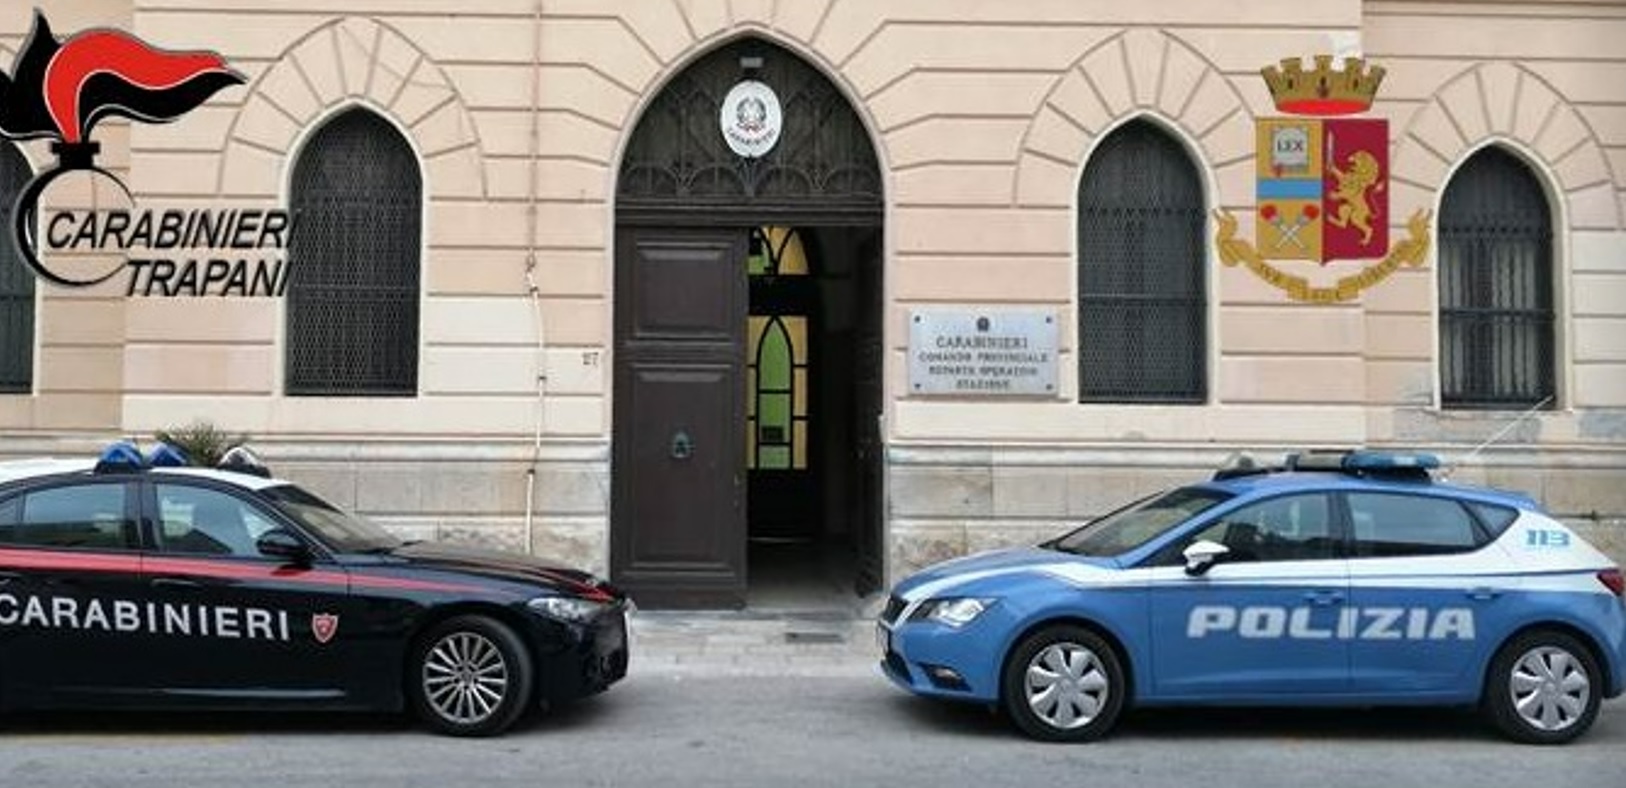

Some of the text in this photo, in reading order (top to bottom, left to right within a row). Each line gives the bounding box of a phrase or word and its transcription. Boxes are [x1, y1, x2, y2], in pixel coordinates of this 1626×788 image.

[935, 335, 1028, 349] CARABINIERI
[1525, 529, 1570, 548] 113
[0, 593, 291, 642] CARABINIERI
[1186, 605, 1475, 640] POLIZIA
